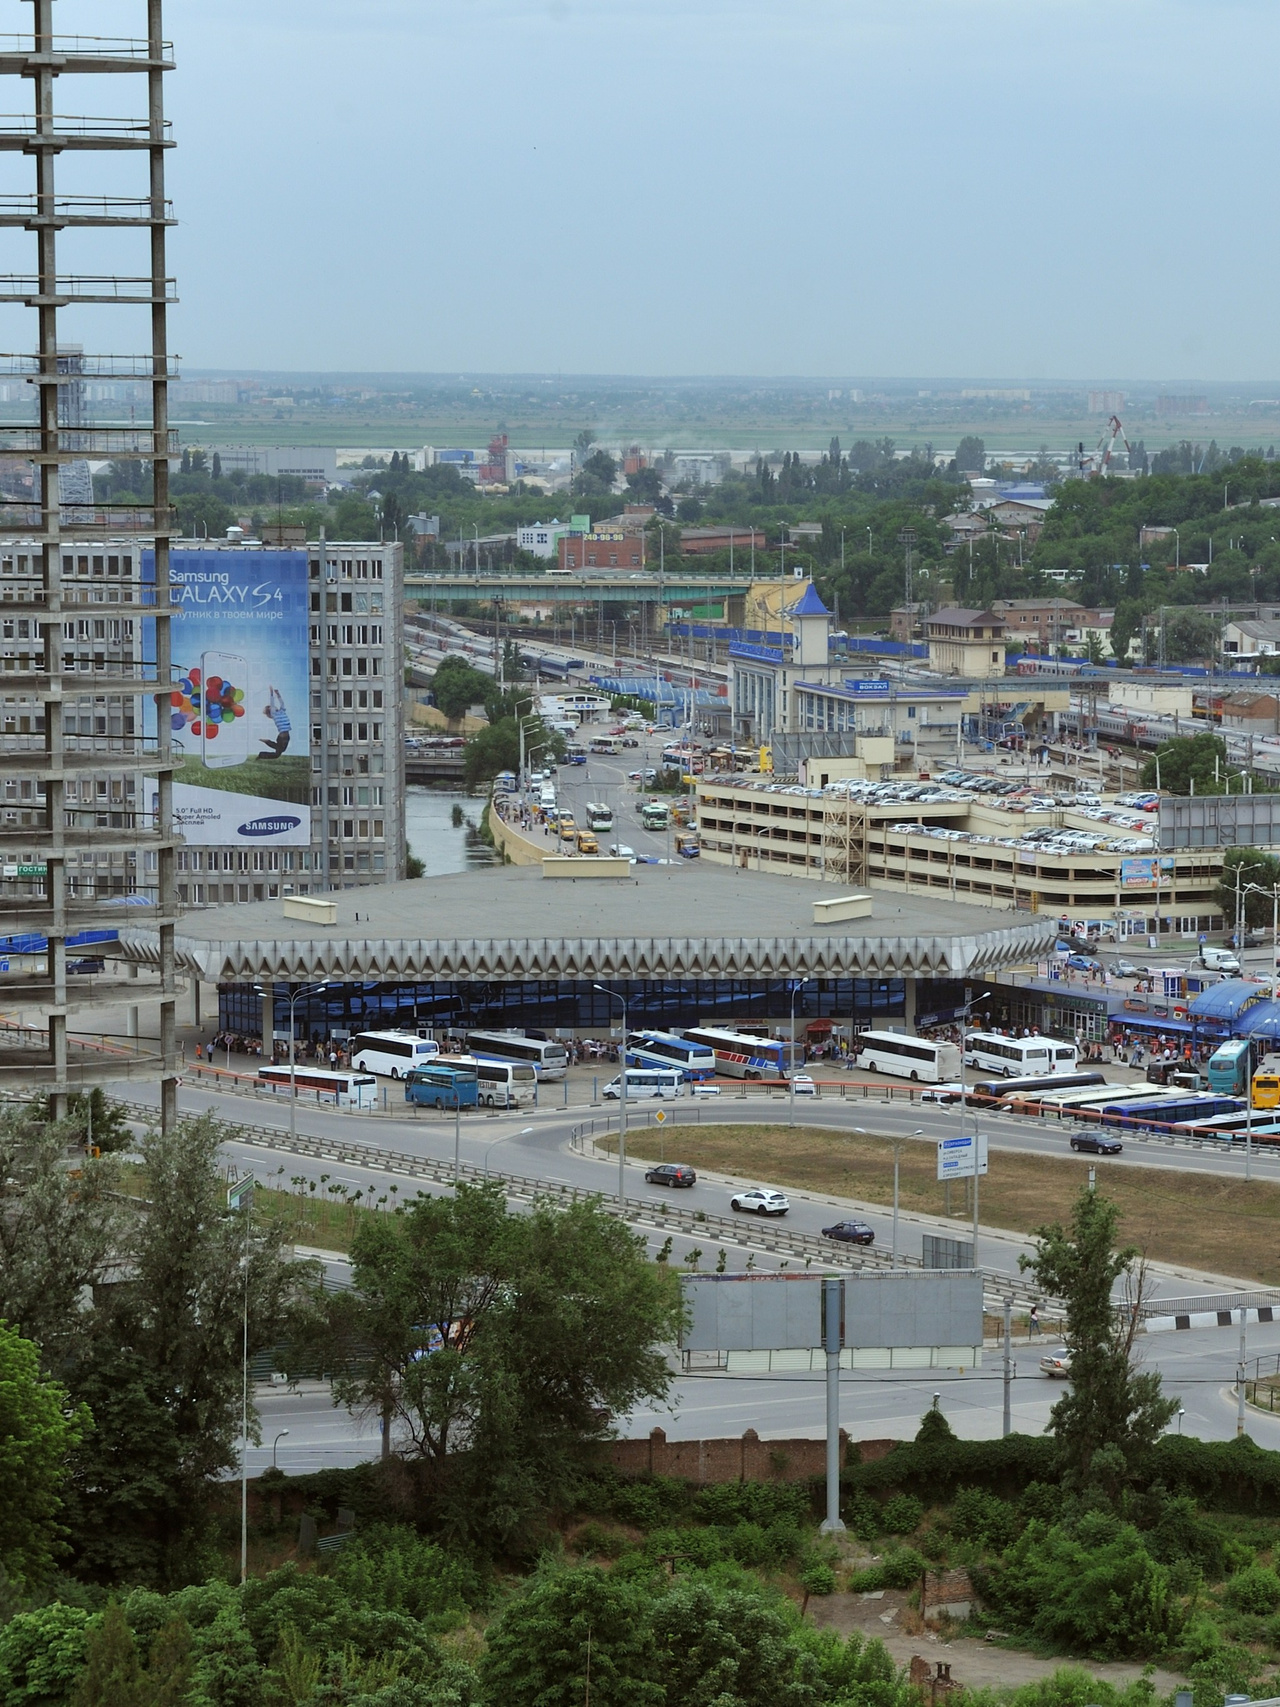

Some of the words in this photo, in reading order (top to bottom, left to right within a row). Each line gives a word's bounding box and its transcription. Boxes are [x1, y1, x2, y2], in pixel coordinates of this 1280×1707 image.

[169, 569, 229, 585] Samsung
[214, 611, 220, 619] в
[223, 611, 254, 620] твоем
[256, 611, 284, 620] мире
[245, 822, 294, 831] SAMSUNG
[1097, 1003, 1104, 1011] 24
